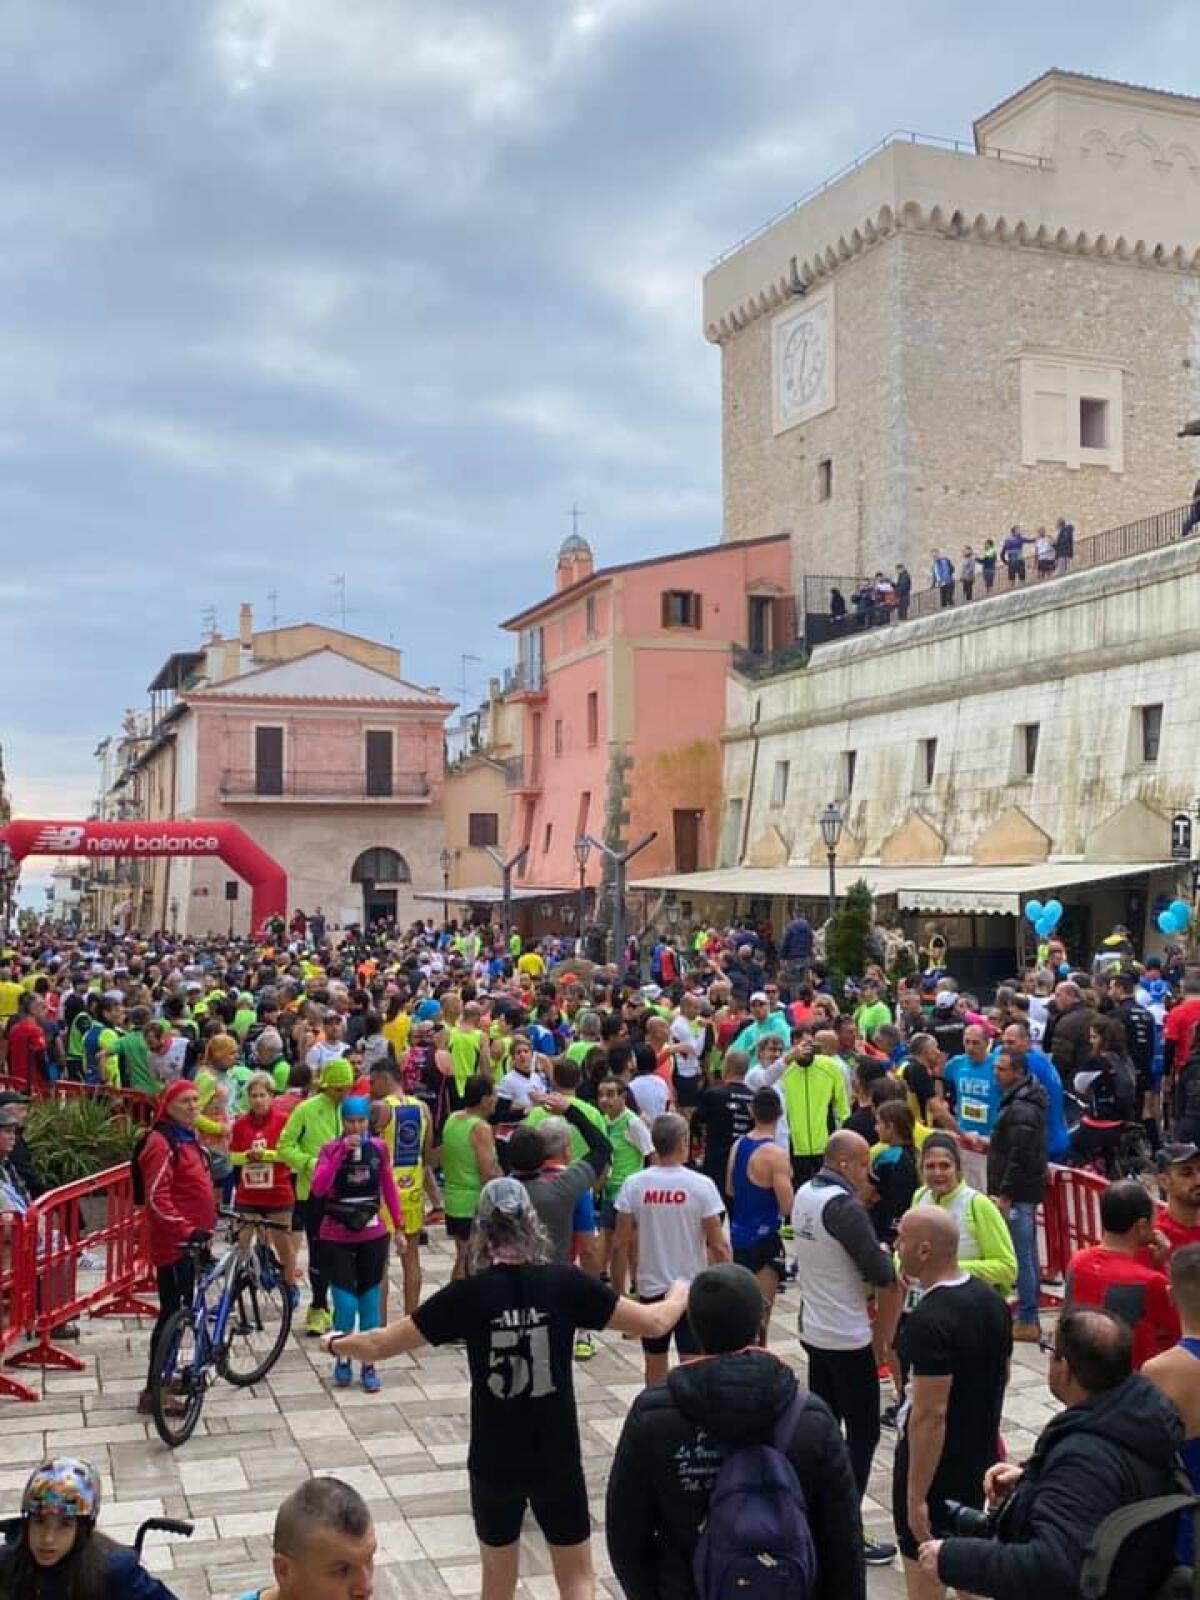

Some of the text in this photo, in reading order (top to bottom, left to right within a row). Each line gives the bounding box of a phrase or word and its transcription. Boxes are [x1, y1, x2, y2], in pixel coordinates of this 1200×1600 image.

[87, 836, 130, 850] new
[134, 834, 219, 851] balance
[643, 1190, 687, 1204] MILO
[488, 1326, 557, 1398] 51
